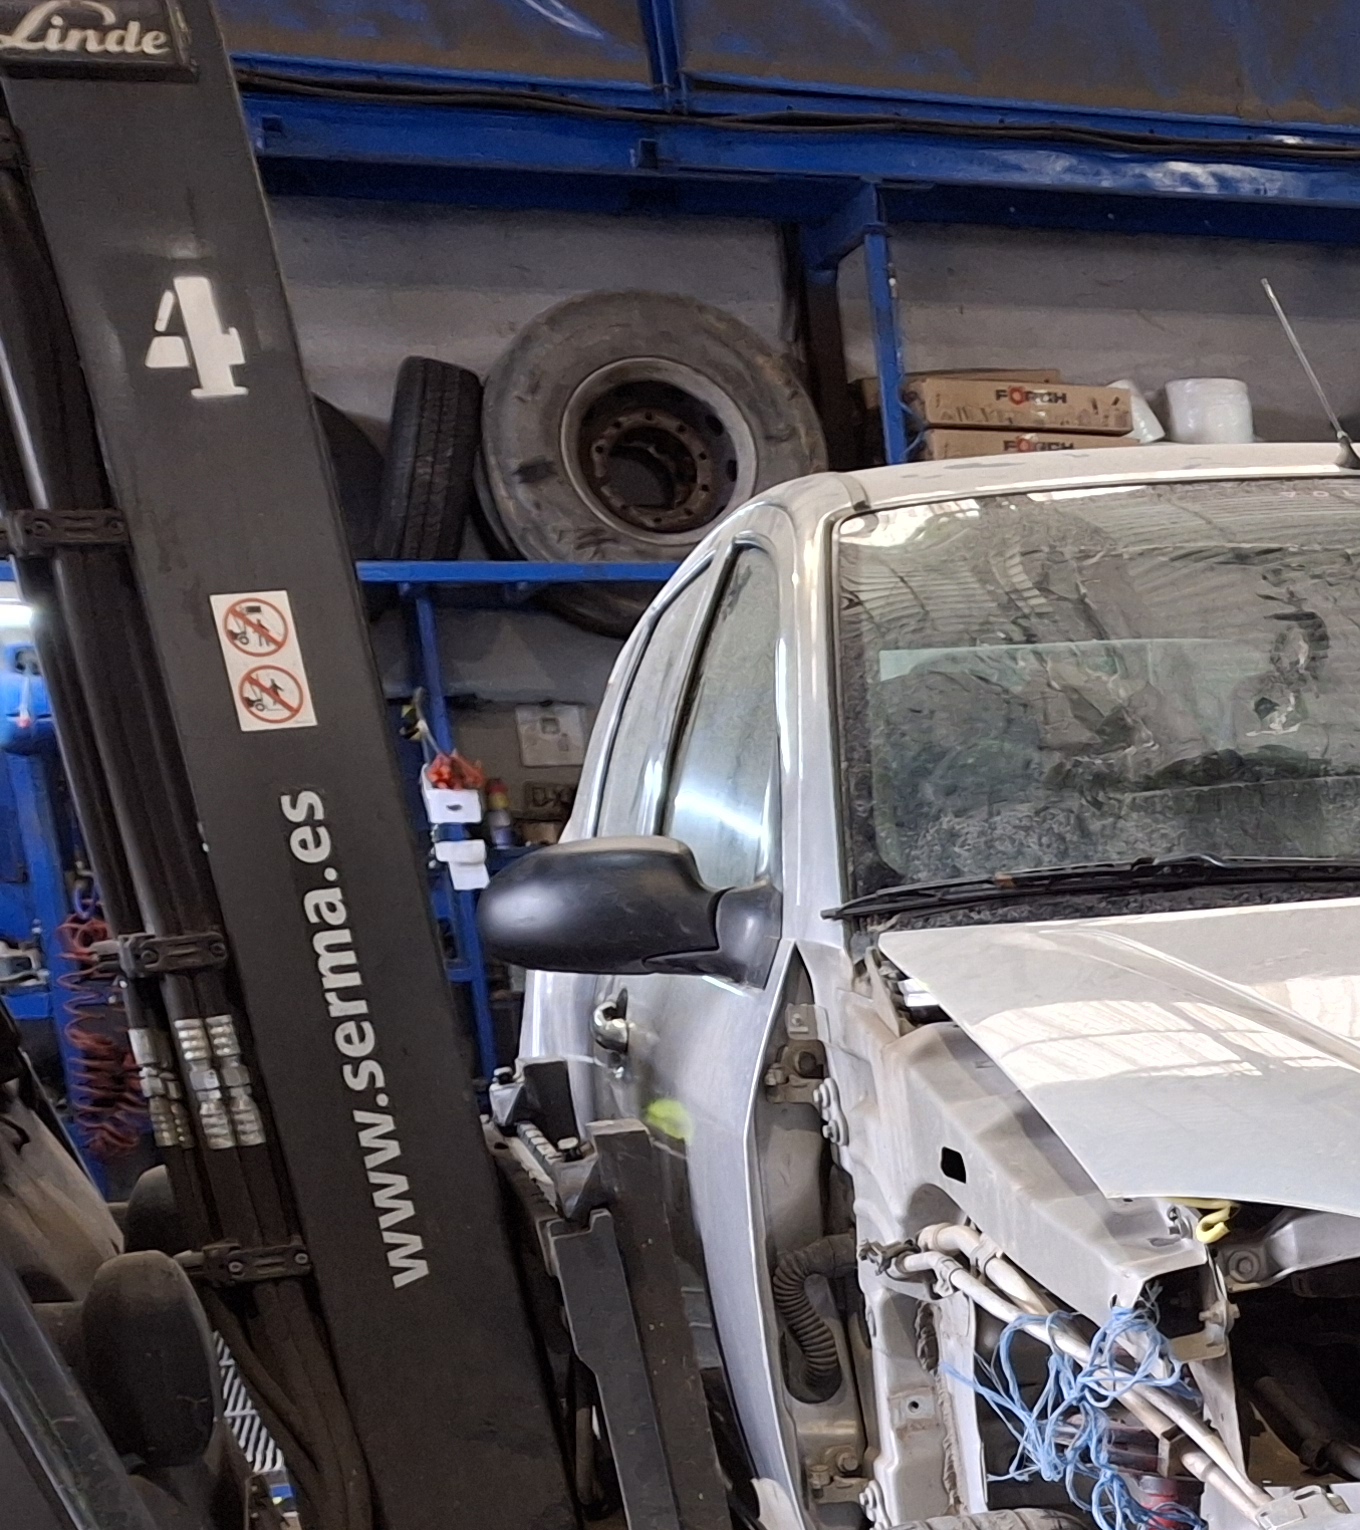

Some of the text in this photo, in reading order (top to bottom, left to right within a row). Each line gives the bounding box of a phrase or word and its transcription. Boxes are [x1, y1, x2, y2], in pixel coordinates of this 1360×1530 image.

[0, 0, 170, 54] Linde
[145, 275, 249, 398] 4
[281, 790, 429, 1289] www.serma.es
